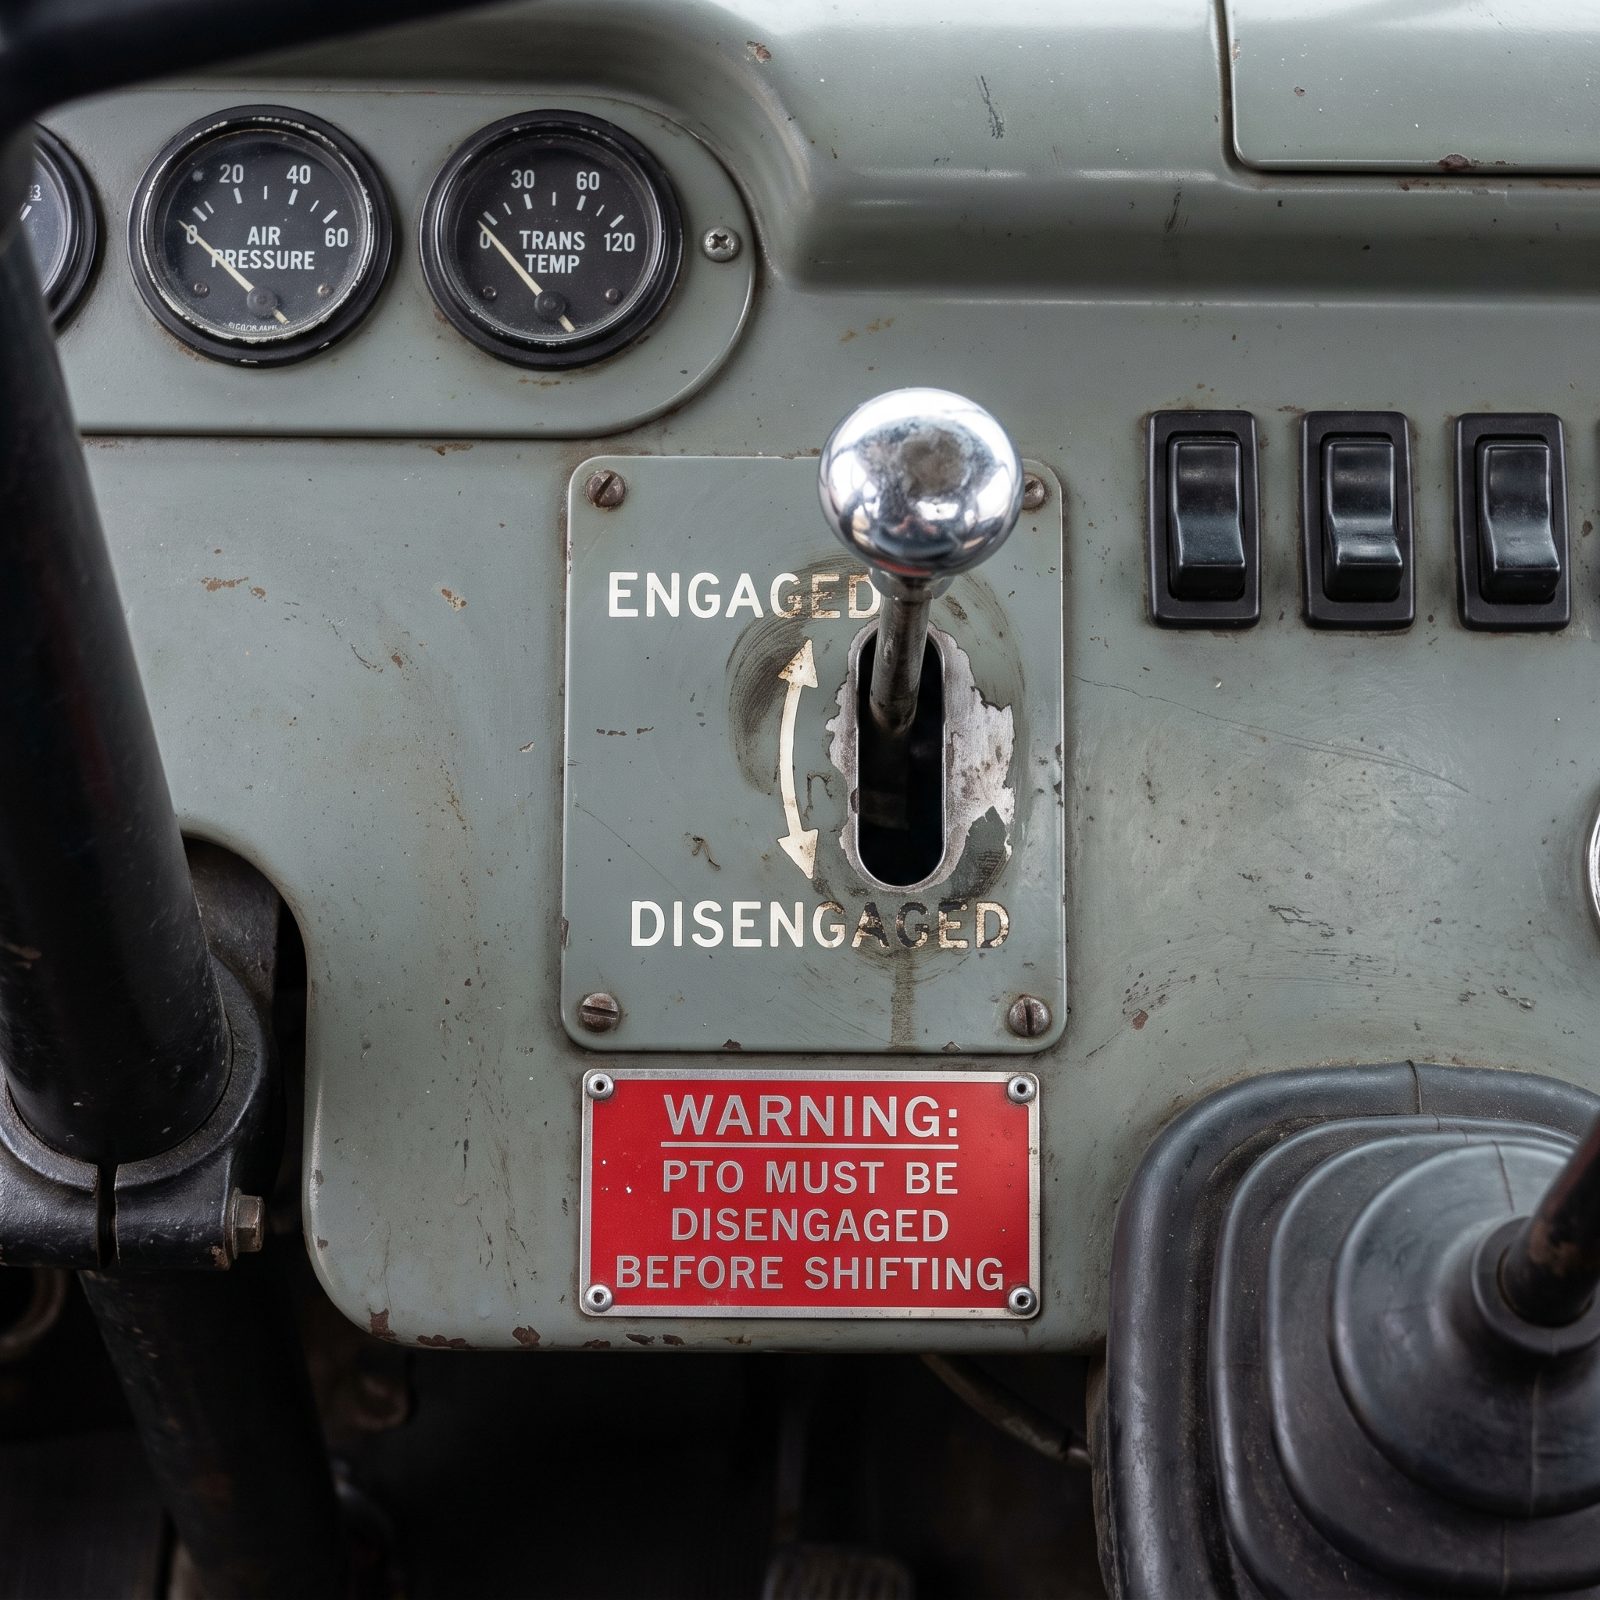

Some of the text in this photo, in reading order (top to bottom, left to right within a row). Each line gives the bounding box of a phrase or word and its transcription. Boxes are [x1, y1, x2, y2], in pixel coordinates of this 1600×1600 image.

[219, 164, 244, 183] 20
[286, 165, 311, 184] 40
[511, 170, 535, 189] 30
[576, 172, 600, 191] 60
[30, 184, 41, 199] 3
[186, 224, 198, 245] 0
[247, 226, 281, 246] AIR
[325, 228, 349, 247] 60
[480, 230, 491, 249] 0
[519, 230, 586, 250] TRANS
[603, 233, 636, 252] 120
[211, 249, 315, 270] PRESSURE
[525, 254, 580, 274] TEMP
[608, 571, 881, 619] ENGAGED
[630, 900, 1010, 949] DISENGAGED
[663, 1094, 958, 1138] WARNING:
[662, 1160, 958, 1195] PTO MUST BE
[671, 1208, 949, 1242] DISENGAGED
[615, 1255, 1004, 1290] BEFORE SHIFTING
